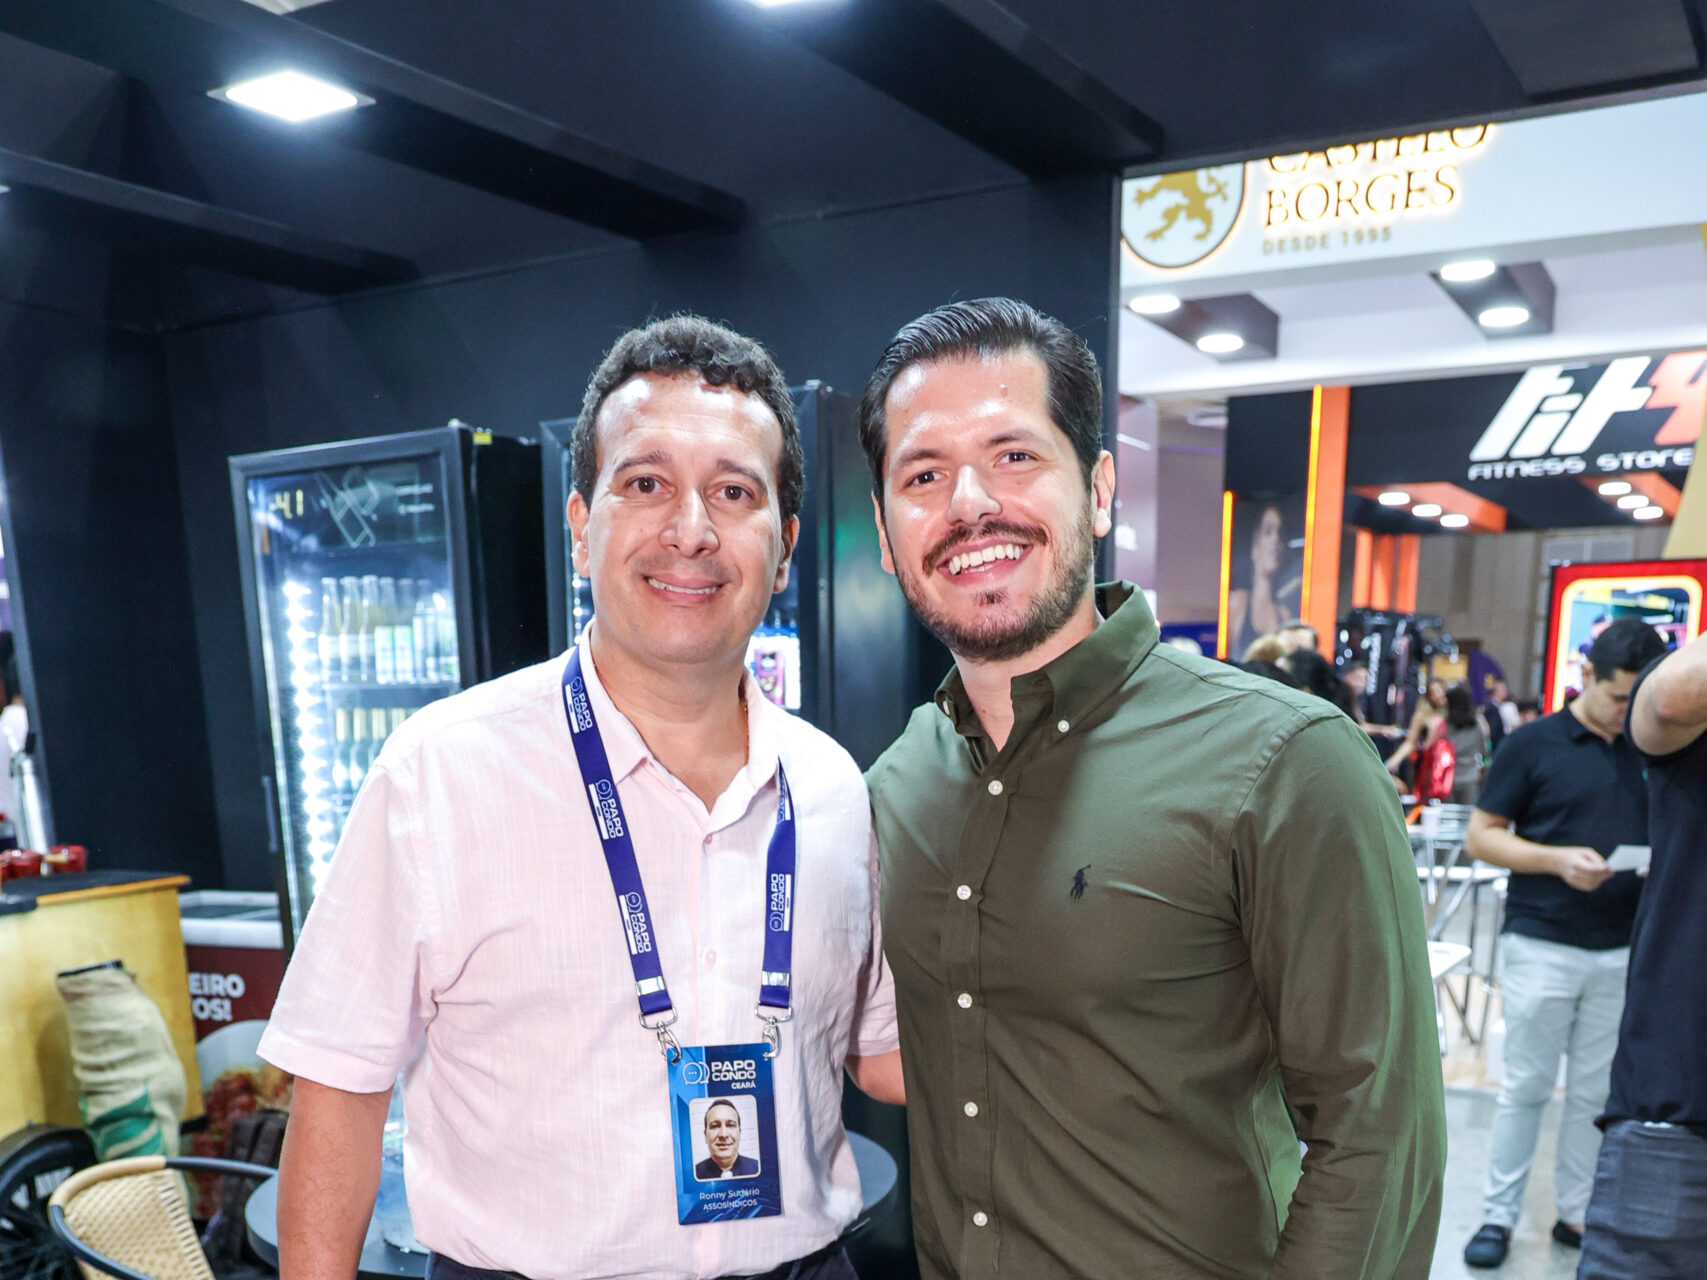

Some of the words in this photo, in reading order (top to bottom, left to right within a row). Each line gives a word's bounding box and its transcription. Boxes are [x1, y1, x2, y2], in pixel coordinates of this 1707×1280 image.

[1265, 163, 1458, 227] BORGES
[1262, 231, 1331, 256] DESDE
[1341, 225, 1393, 246] 1995
[579, 692, 593, 729] PAPO
[601, 800, 617, 839] CONDO
[607, 798, 624, 837] PAPO
[770, 873, 779, 911] PAPO
[630, 913, 645, 953] CONDO
[637, 912, 652, 952] PAPO
[711, 1060, 756, 1073] PAPO
[711, 1070, 757, 1082] CONDO
[731, 1080, 757, 1089] CEARÁ
[699, 1191, 726, 1201] Ronny
